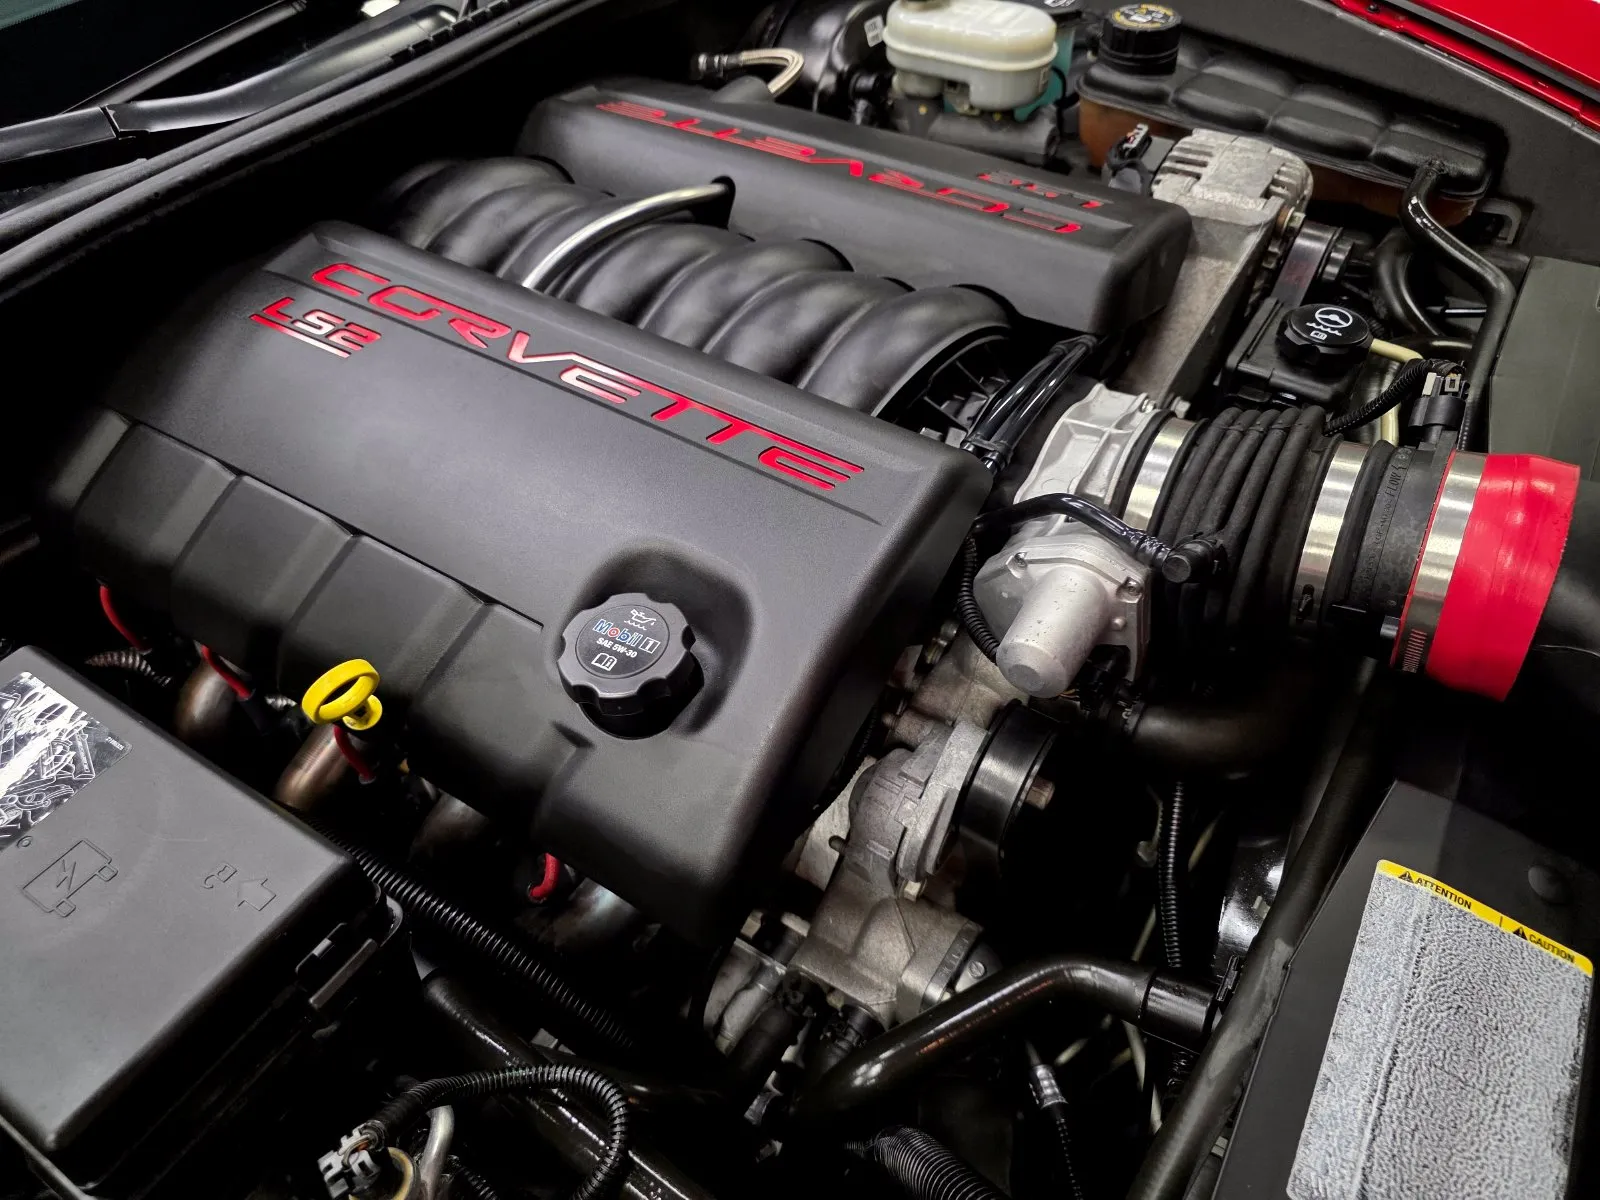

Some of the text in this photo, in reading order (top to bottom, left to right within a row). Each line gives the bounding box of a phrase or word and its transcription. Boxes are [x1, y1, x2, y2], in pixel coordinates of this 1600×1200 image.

[596, 101, 1082, 234] CORVETTE
[261, 296, 382, 352] LS2
[311, 262, 864, 491] CORVETTE
[593, 619, 643, 647] Mobil
[596, 638, 638, 658] SAE 5W-30
[1415, 877, 1472, 910] ATTENTION
[1529, 934, 1576, 964] CAUTION
